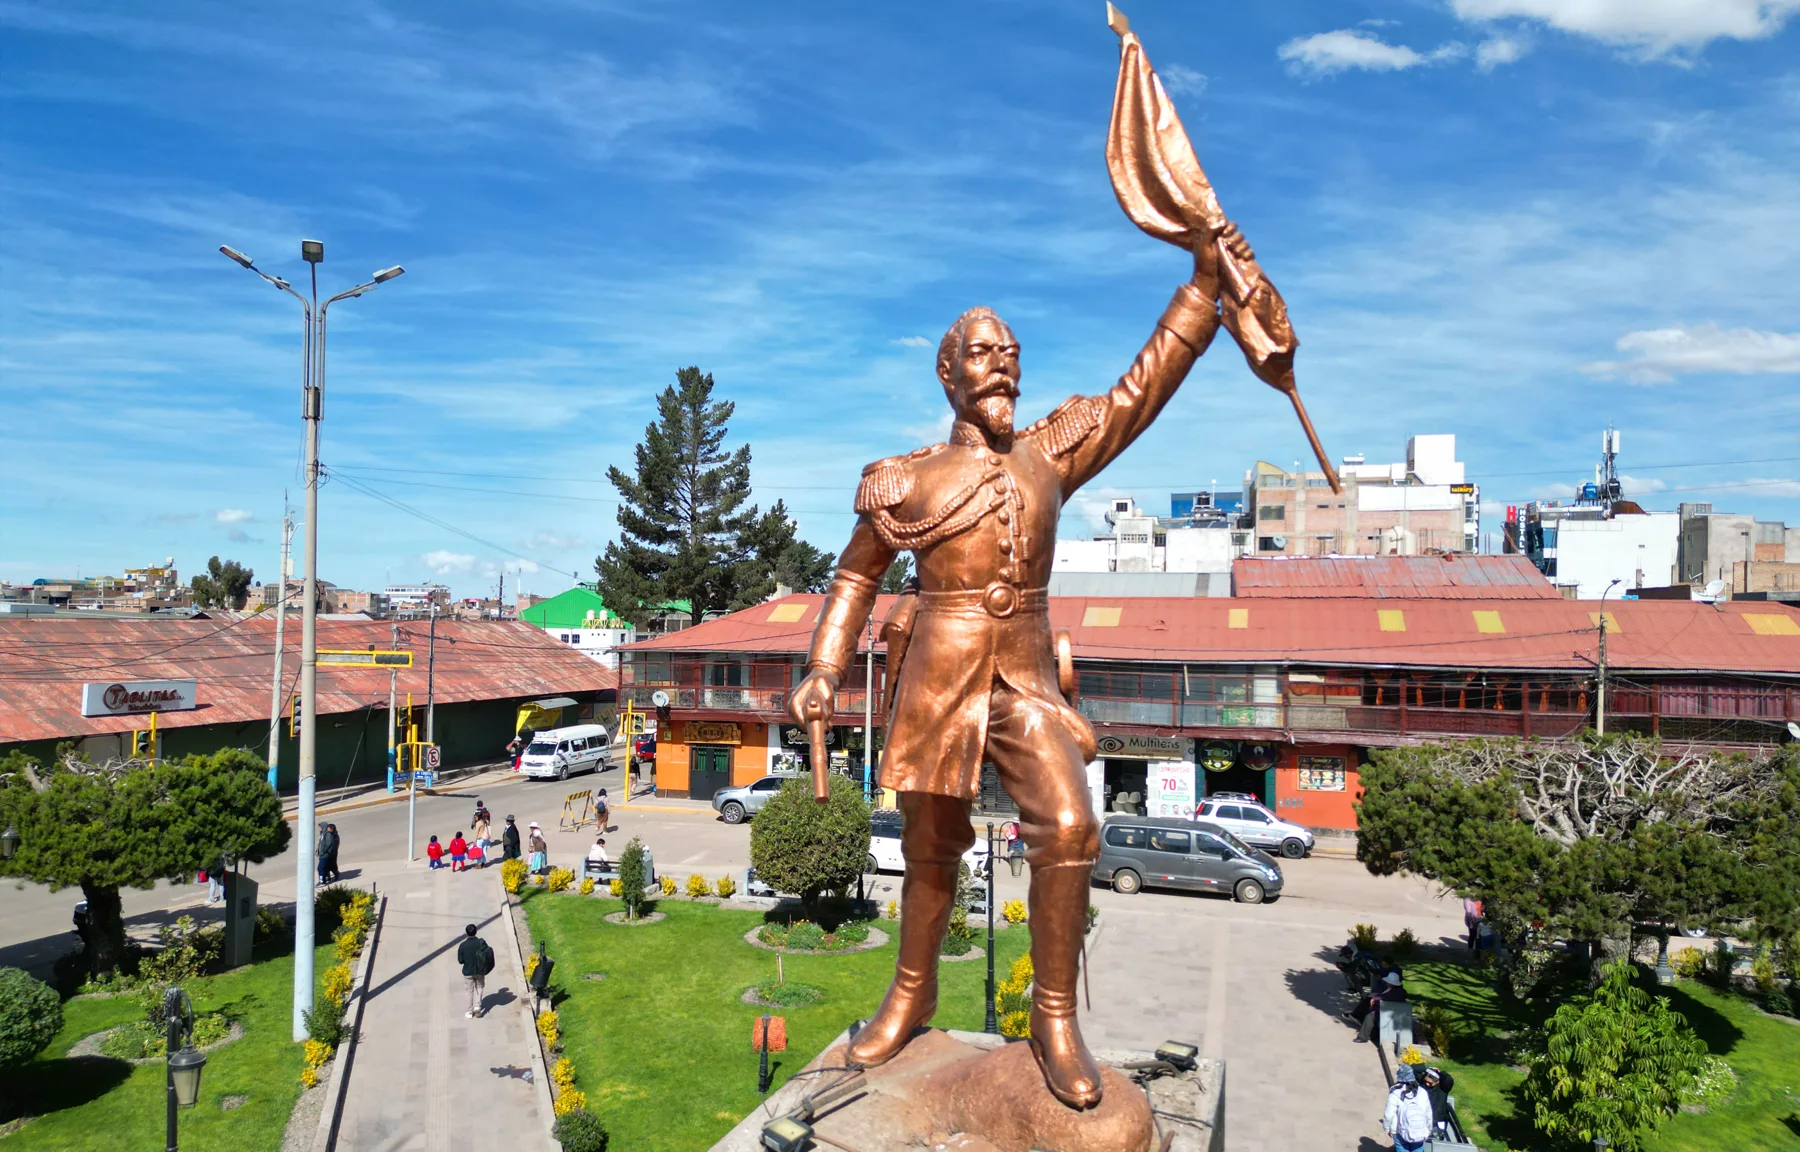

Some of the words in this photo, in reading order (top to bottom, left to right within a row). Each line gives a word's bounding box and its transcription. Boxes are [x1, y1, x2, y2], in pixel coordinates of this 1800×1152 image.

[1507, 505, 1516, 523] H
[1129, 737, 1180, 749] Multilens
[1161, 779, 1177, 791] 70
